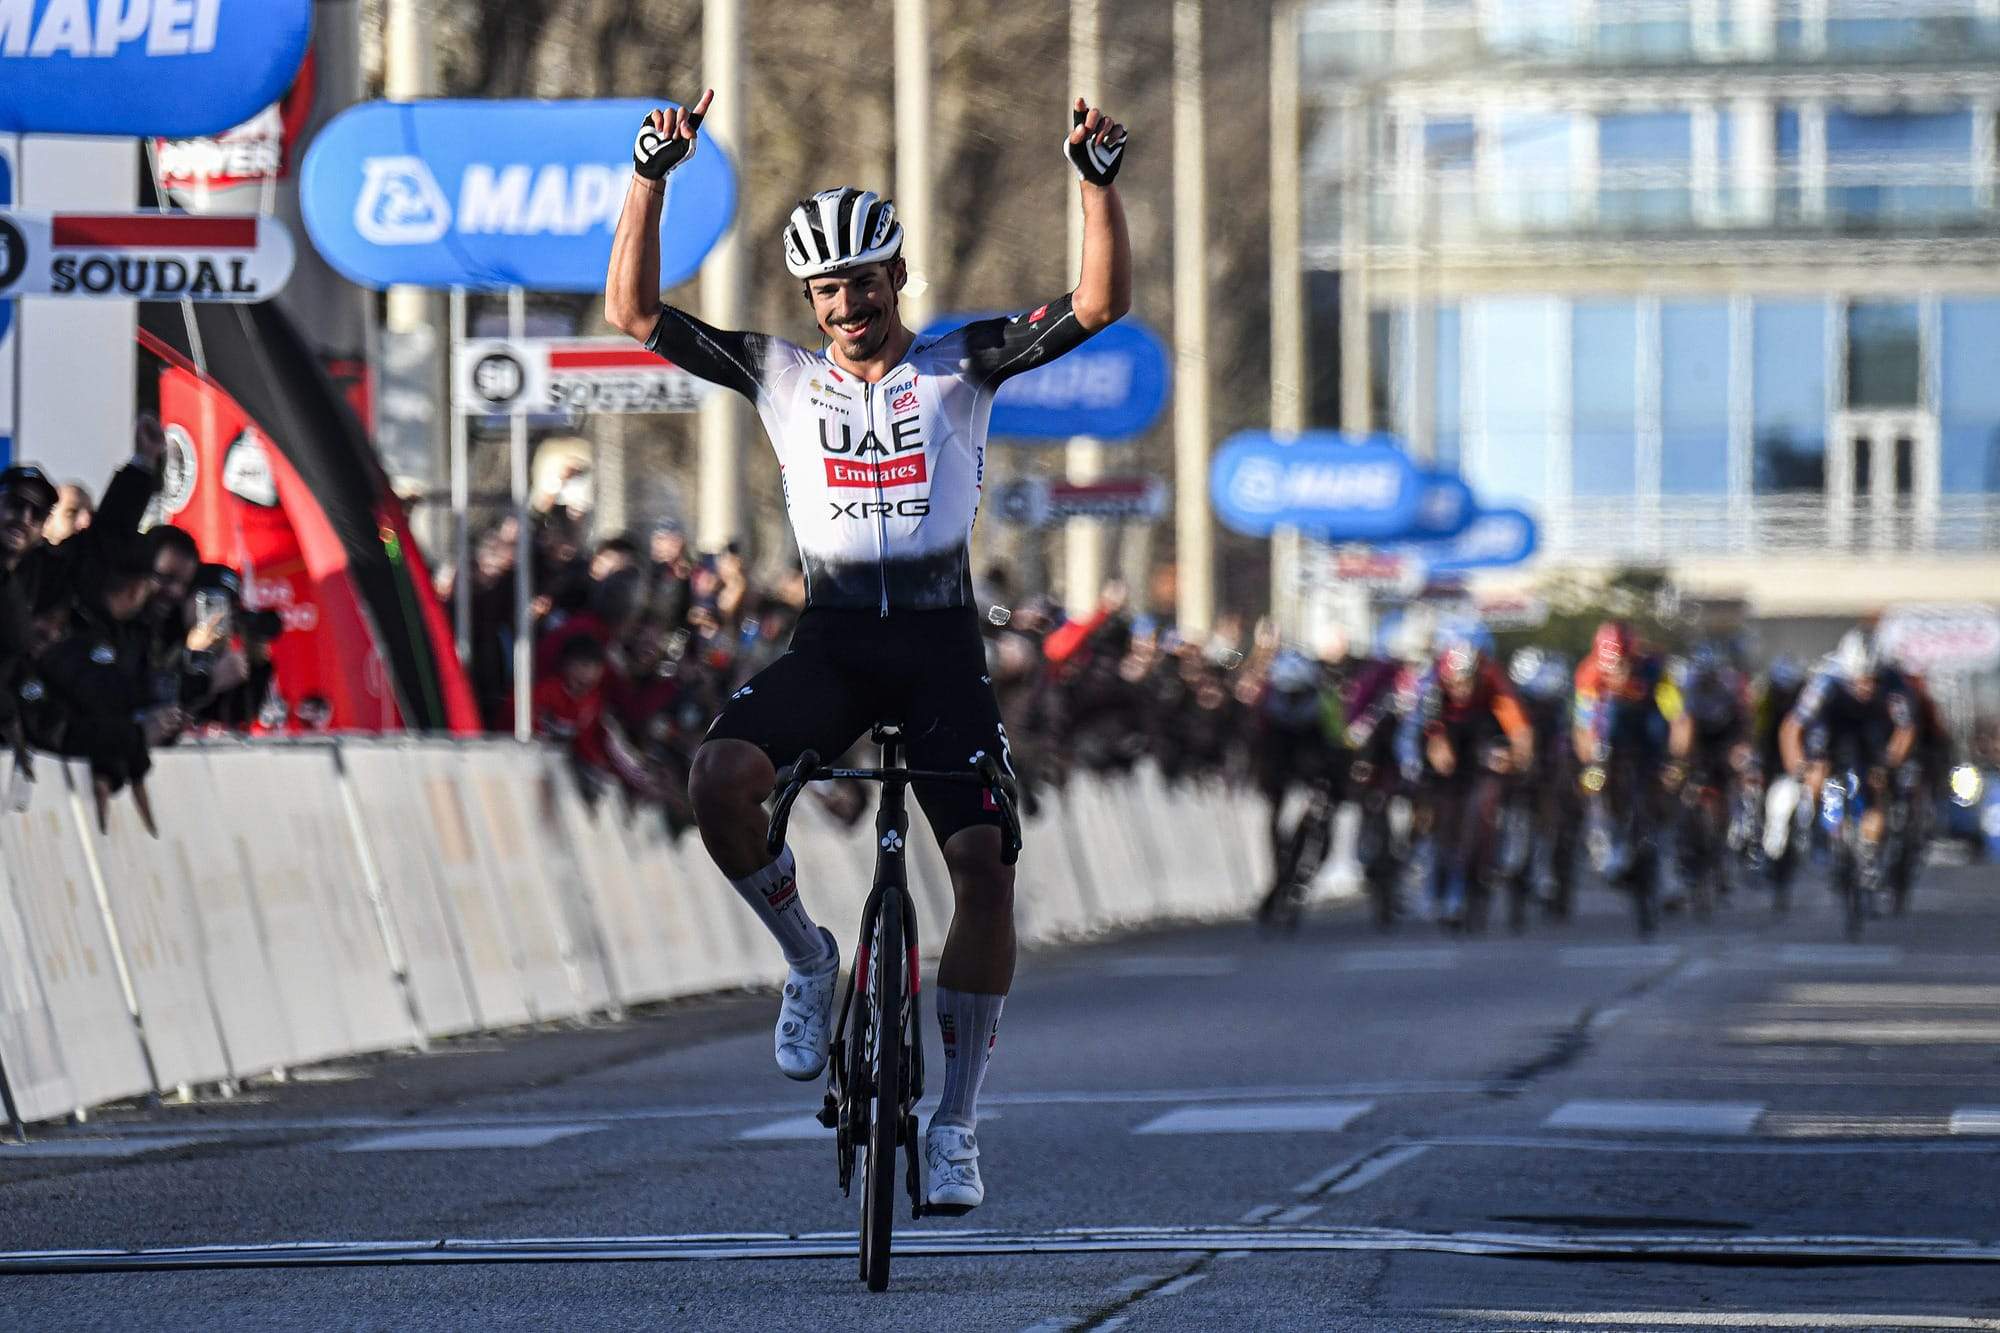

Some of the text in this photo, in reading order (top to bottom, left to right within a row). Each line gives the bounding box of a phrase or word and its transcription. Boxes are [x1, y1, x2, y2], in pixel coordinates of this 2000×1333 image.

[52, 257, 256, 294] SOUDAL
[889, 381, 913, 396] FAB
[819, 414, 924, 457] UAE
[834, 463, 918, 483] Emirates
[830, 498, 931, 521] XRG
